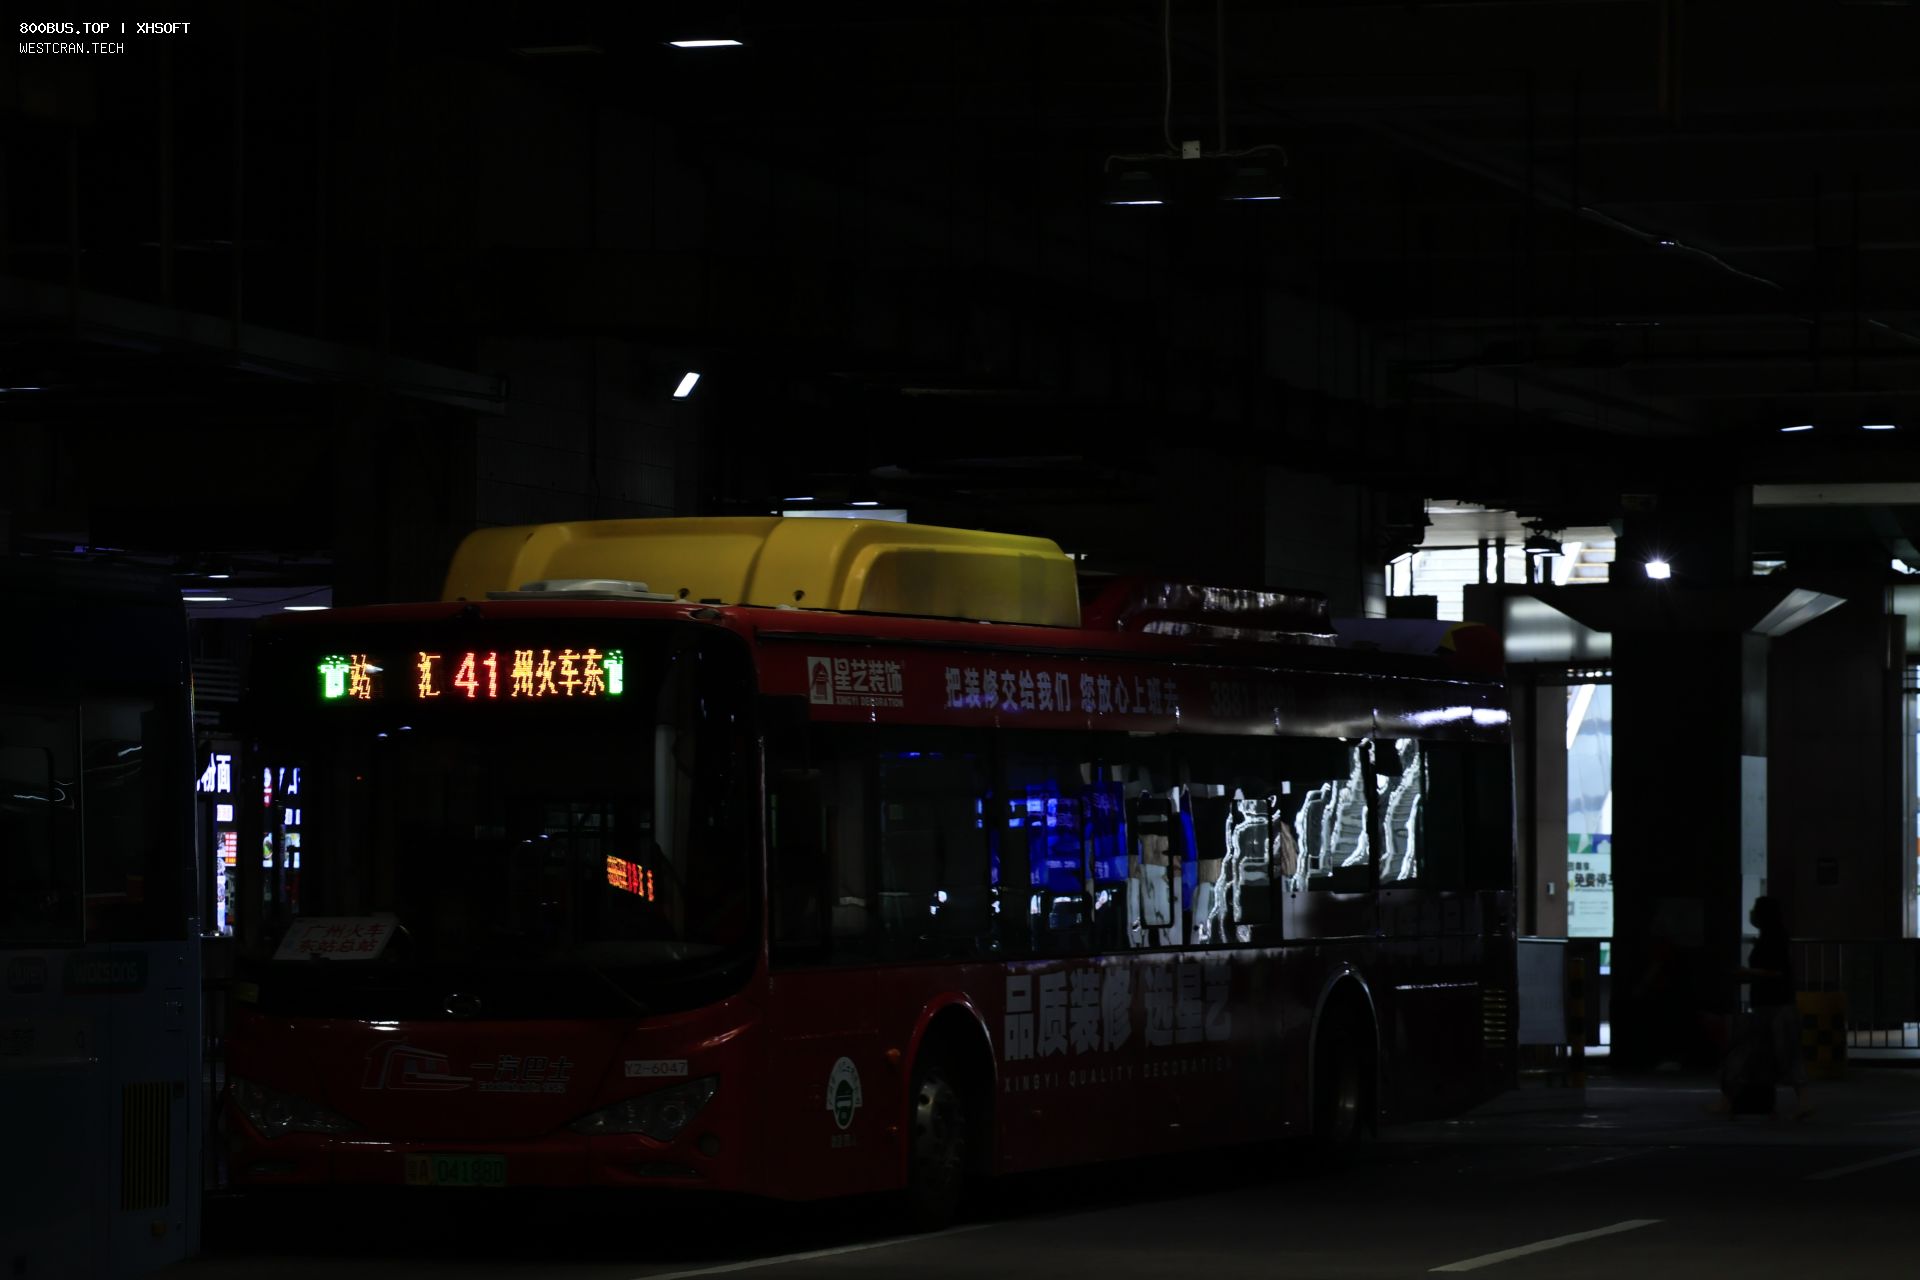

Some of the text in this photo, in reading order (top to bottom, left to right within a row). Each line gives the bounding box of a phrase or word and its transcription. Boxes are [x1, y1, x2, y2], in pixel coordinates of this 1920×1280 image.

[454, 652, 497, 697] 41
[833, 657, 904, 693] 星艺装饰
[944, 666, 1072, 712] 把装修交给我们
[302, 923, 385, 938] 广州火车
[1004, 966, 1132, 1062] 品质装修
[470, 1055, 576, 1081] 一汽巴士
[1004, 1072, 1060, 1093] XINGYI
[1069, 1063, 1134, 1088] QUALITY
